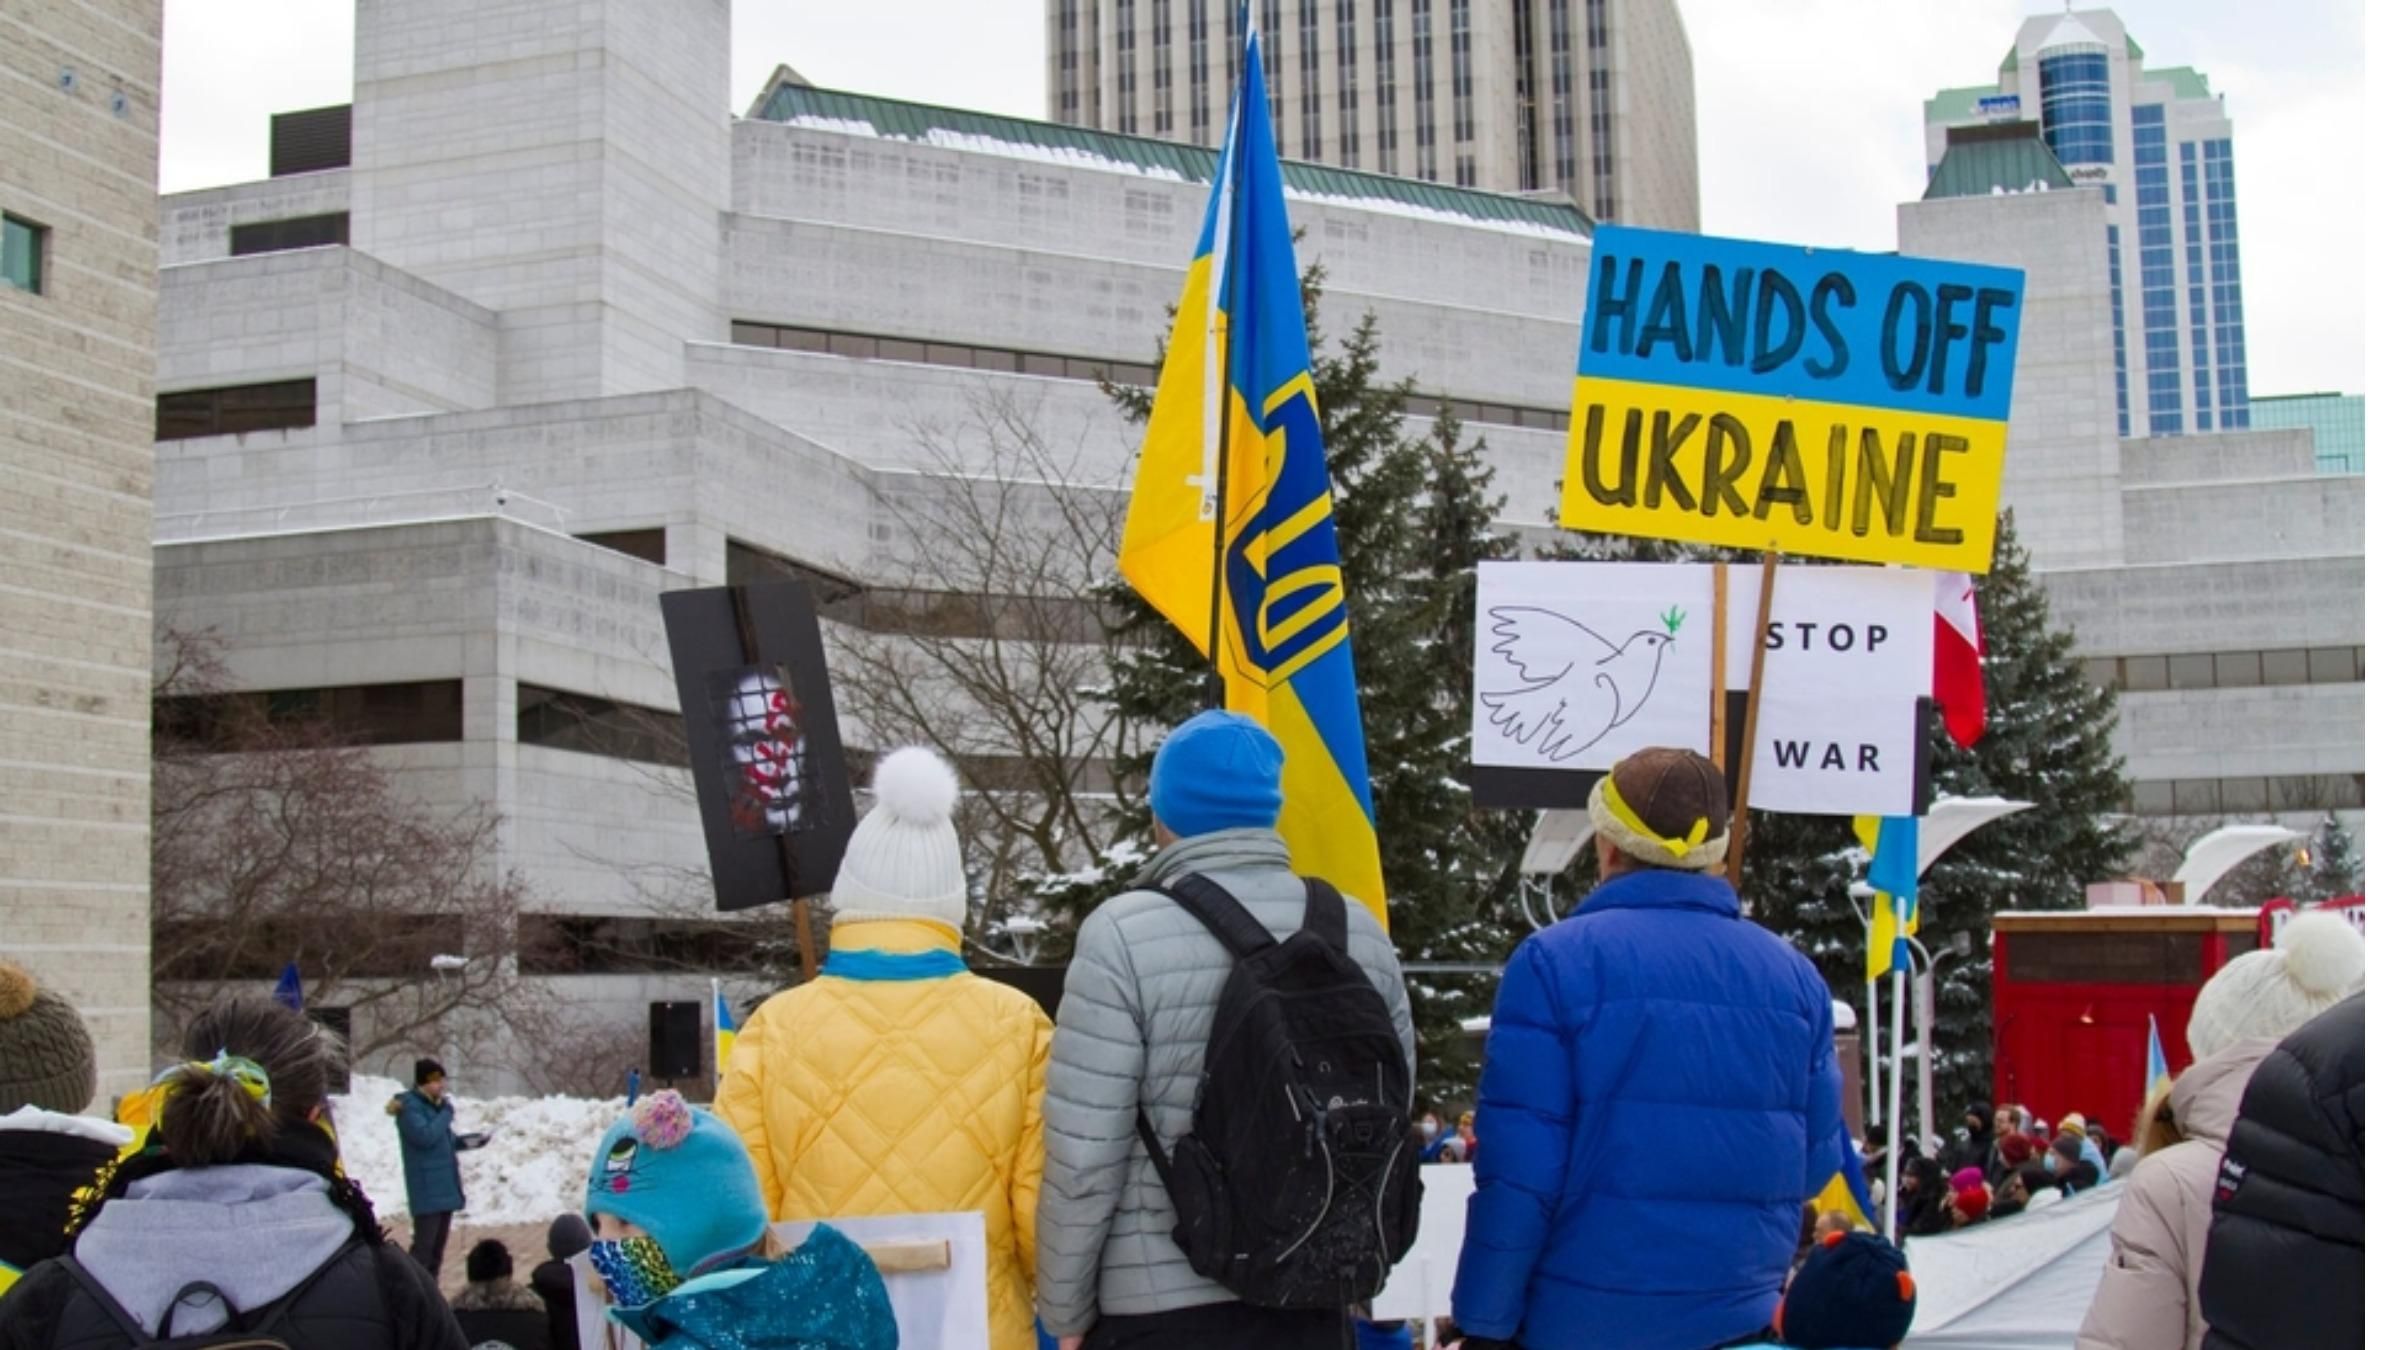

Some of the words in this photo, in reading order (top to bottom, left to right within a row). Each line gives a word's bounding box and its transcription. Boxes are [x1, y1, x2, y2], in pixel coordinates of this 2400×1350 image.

[1591, 256, 1857, 379] HANDS
[1882, 280, 2015, 396] OFF
[1581, 404, 1969, 544] UKRAINE
[1766, 622, 1888, 652] STOP
[1773, 740, 1880, 772] WAR
